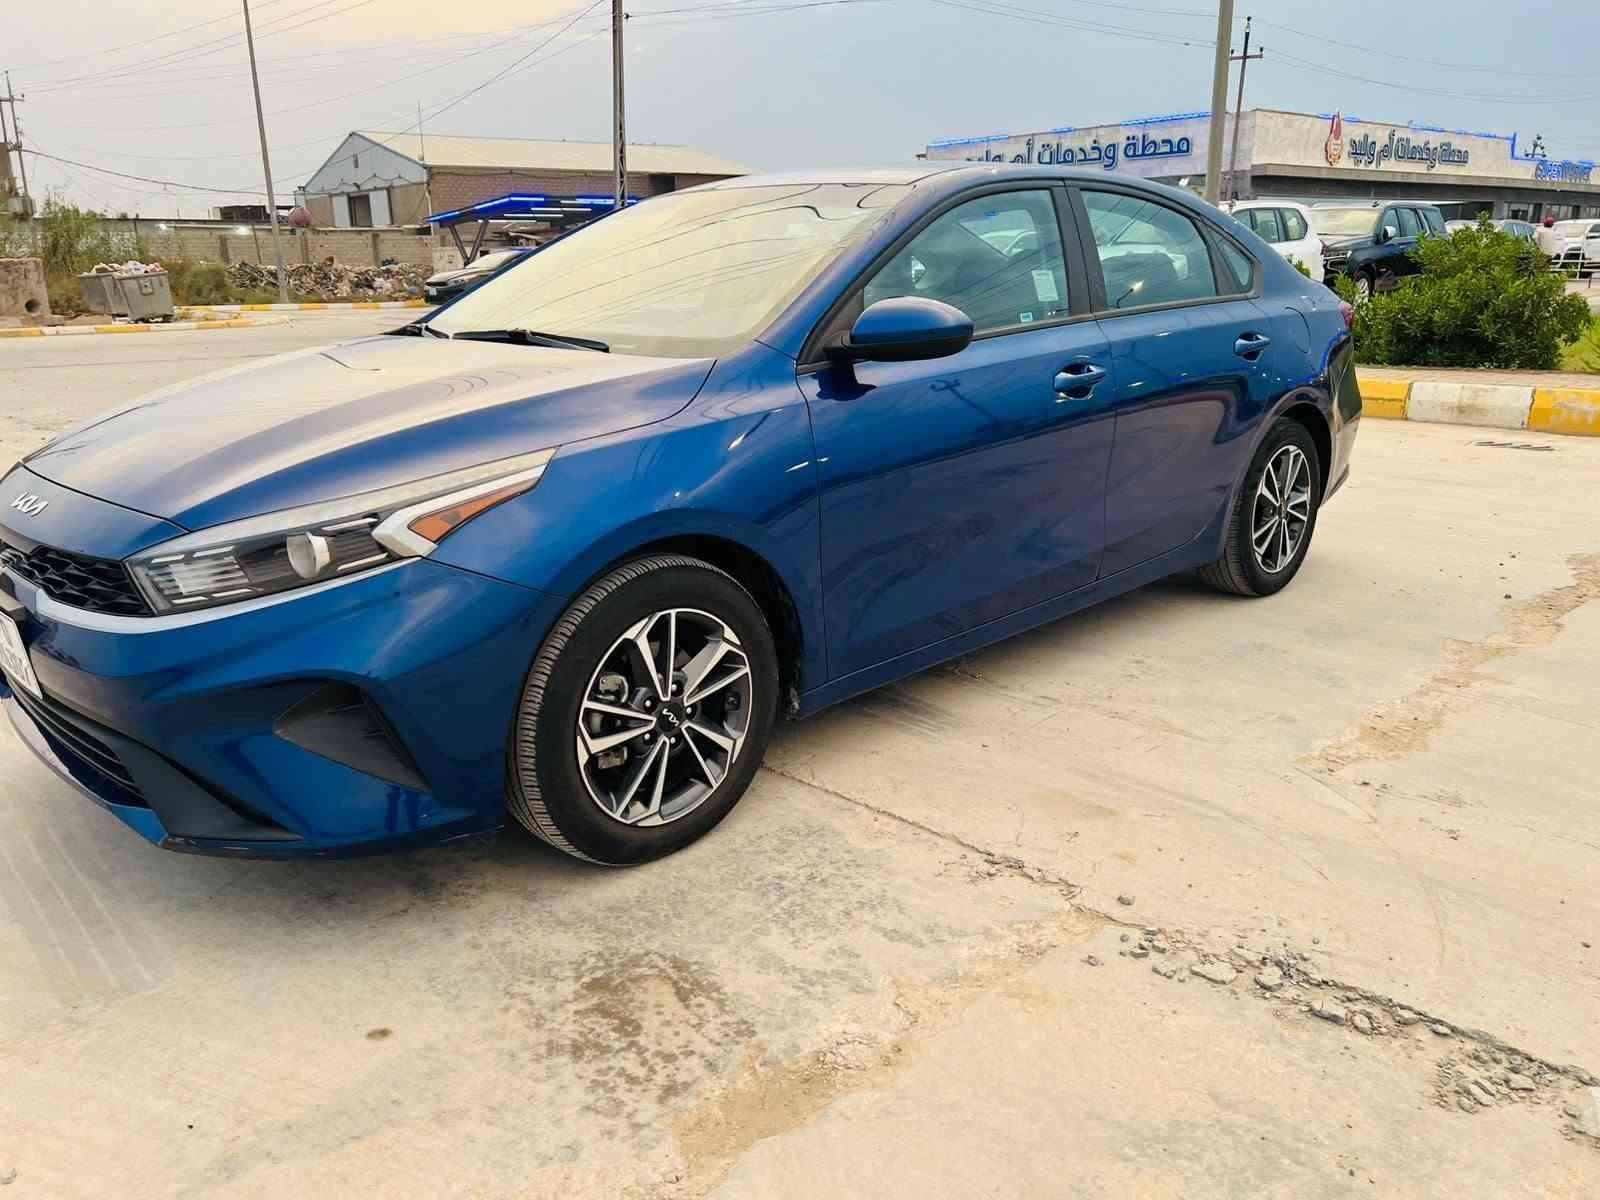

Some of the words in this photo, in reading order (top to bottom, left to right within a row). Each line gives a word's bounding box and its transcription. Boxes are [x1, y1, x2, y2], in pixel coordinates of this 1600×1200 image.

[1038, 139, 1119, 170] وخدمات
[1124, 134, 1191, 158] محطة
[1349, 134, 1376, 165] وليد
[1377, 130, 1395, 167] أم
[1396, 137, 1438, 168] وخدمات
[1439, 141, 1469, 163] محطة
